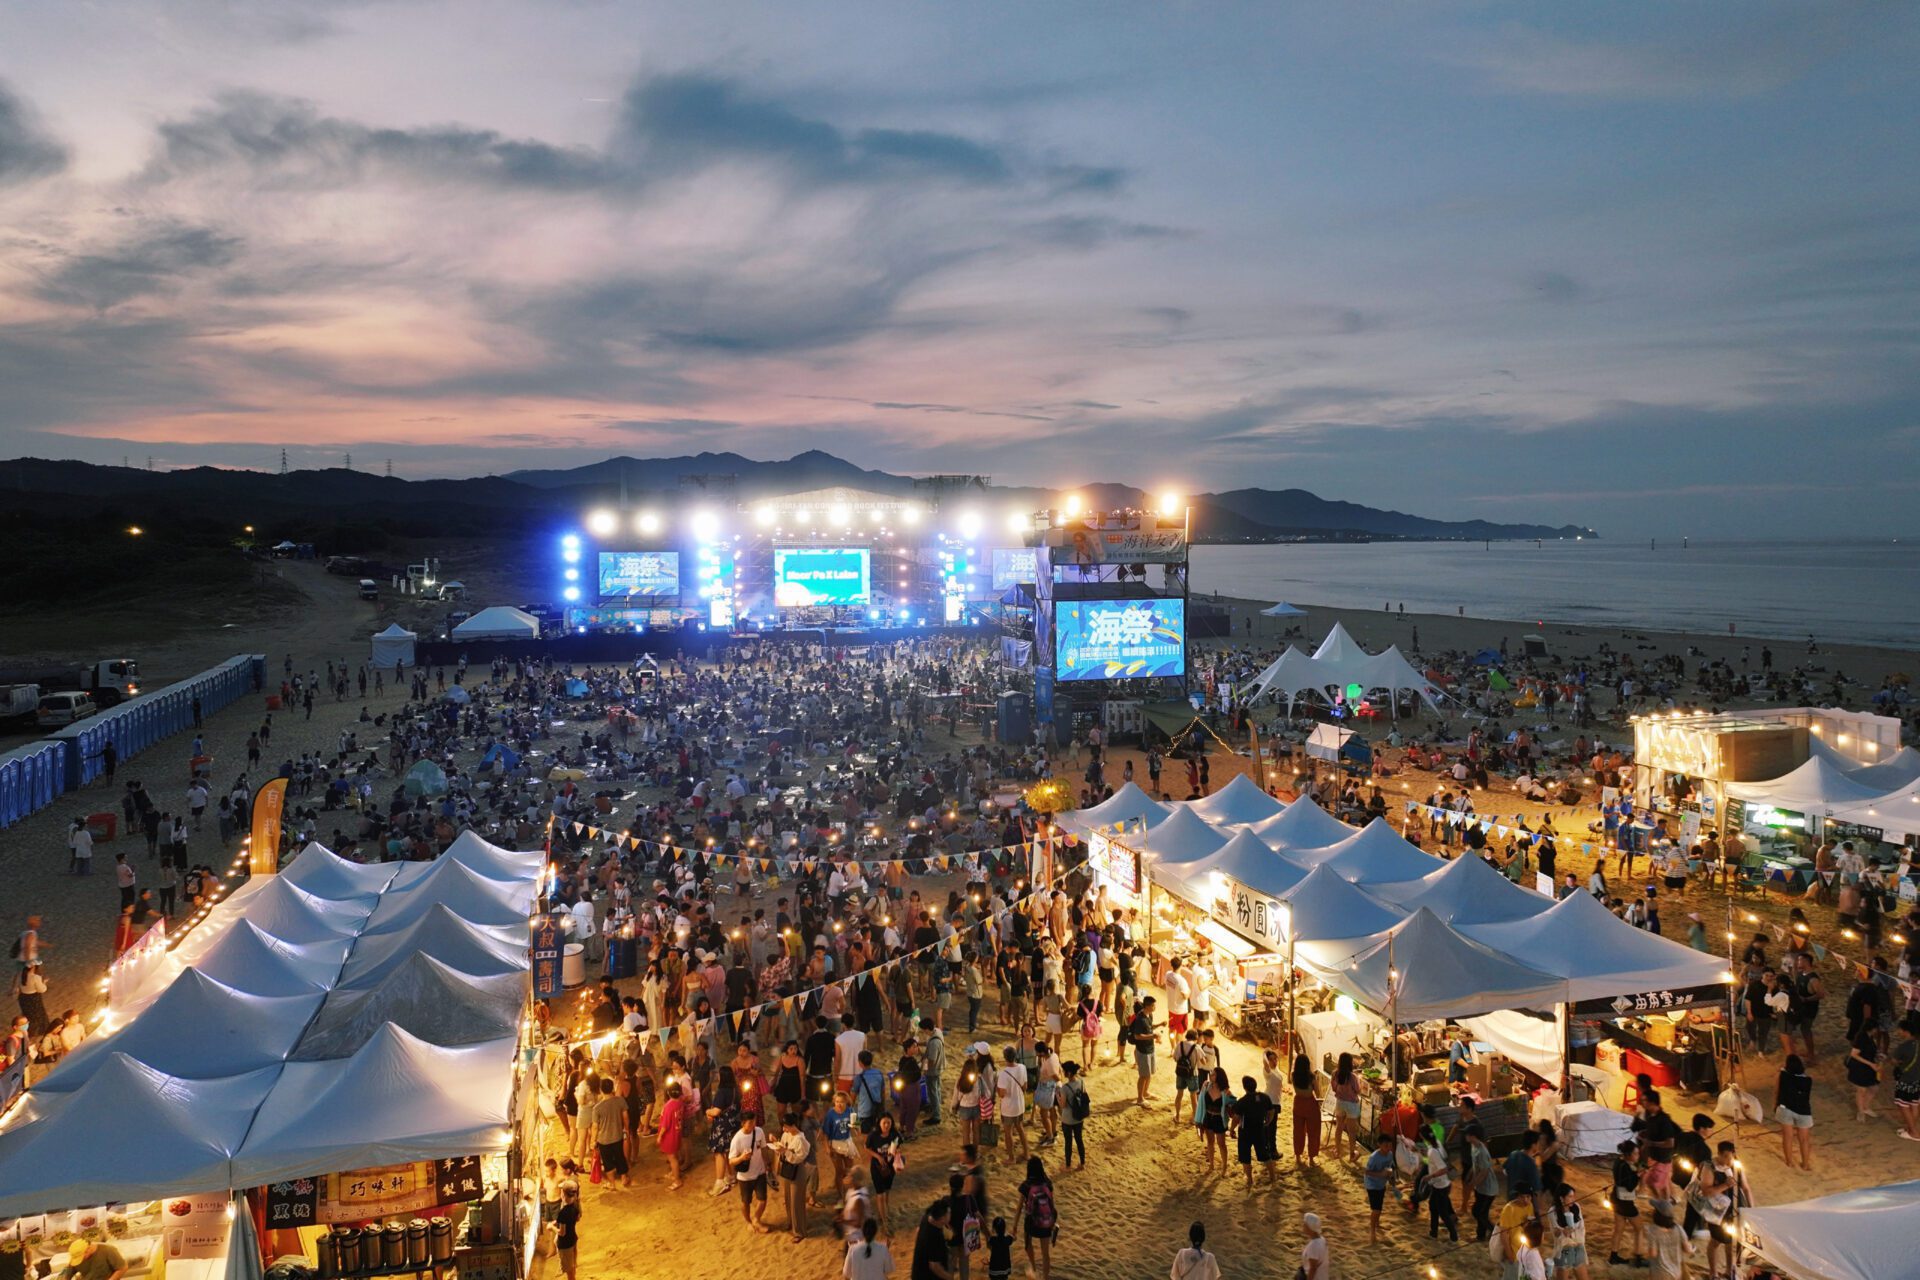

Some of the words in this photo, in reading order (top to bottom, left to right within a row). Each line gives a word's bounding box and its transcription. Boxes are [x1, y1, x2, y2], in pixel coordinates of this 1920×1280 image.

[1089, 608, 1154, 645] 海祭
[539, 916, 555, 948] 大叔
[1237, 890, 1288, 946] 粉圓冰
[538, 960, 552, 993] 壽司
[442, 1156, 475, 1173] 手工
[350, 1176, 405, 1197] 巧味軒
[272, 1202, 311, 1220] 黑糖
